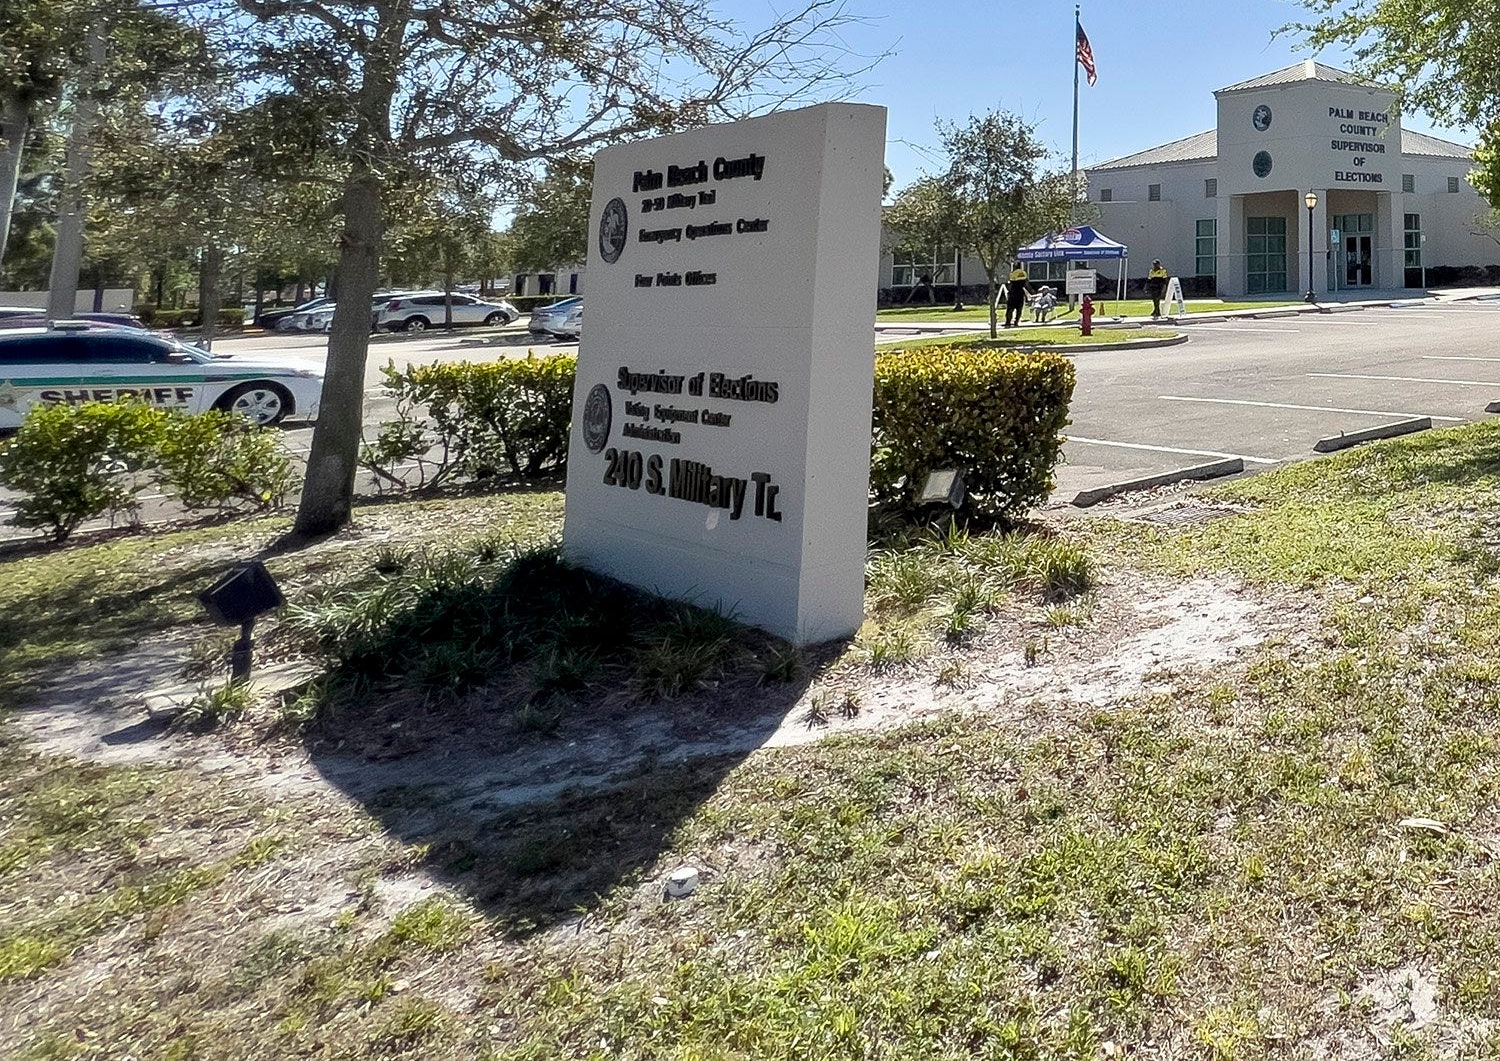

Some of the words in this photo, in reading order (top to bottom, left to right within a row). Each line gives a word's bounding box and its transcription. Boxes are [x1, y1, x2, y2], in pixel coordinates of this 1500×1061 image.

[1329, 107, 1353, 119] PALM
[1359, 111, 1388, 123] BEACH
[1340, 124, 1377, 136] COUNTY
[1331, 140, 1385, 153] SUPERVISOR
[1353, 157, 1366, 166] OF
[632, 169, 663, 192] Palm
[667, 160, 708, 188] Beach
[713, 154, 766, 181] County
[1335, 171, 1382, 183] ELECTIONS
[617, 366, 685, 395] Supervisor
[688, 372, 705, 396] of
[709, 372, 779, 403] Elections
[603, 448, 643, 490] 240
[645, 454, 666, 496] S.
[669, 458, 747, 520] Military
